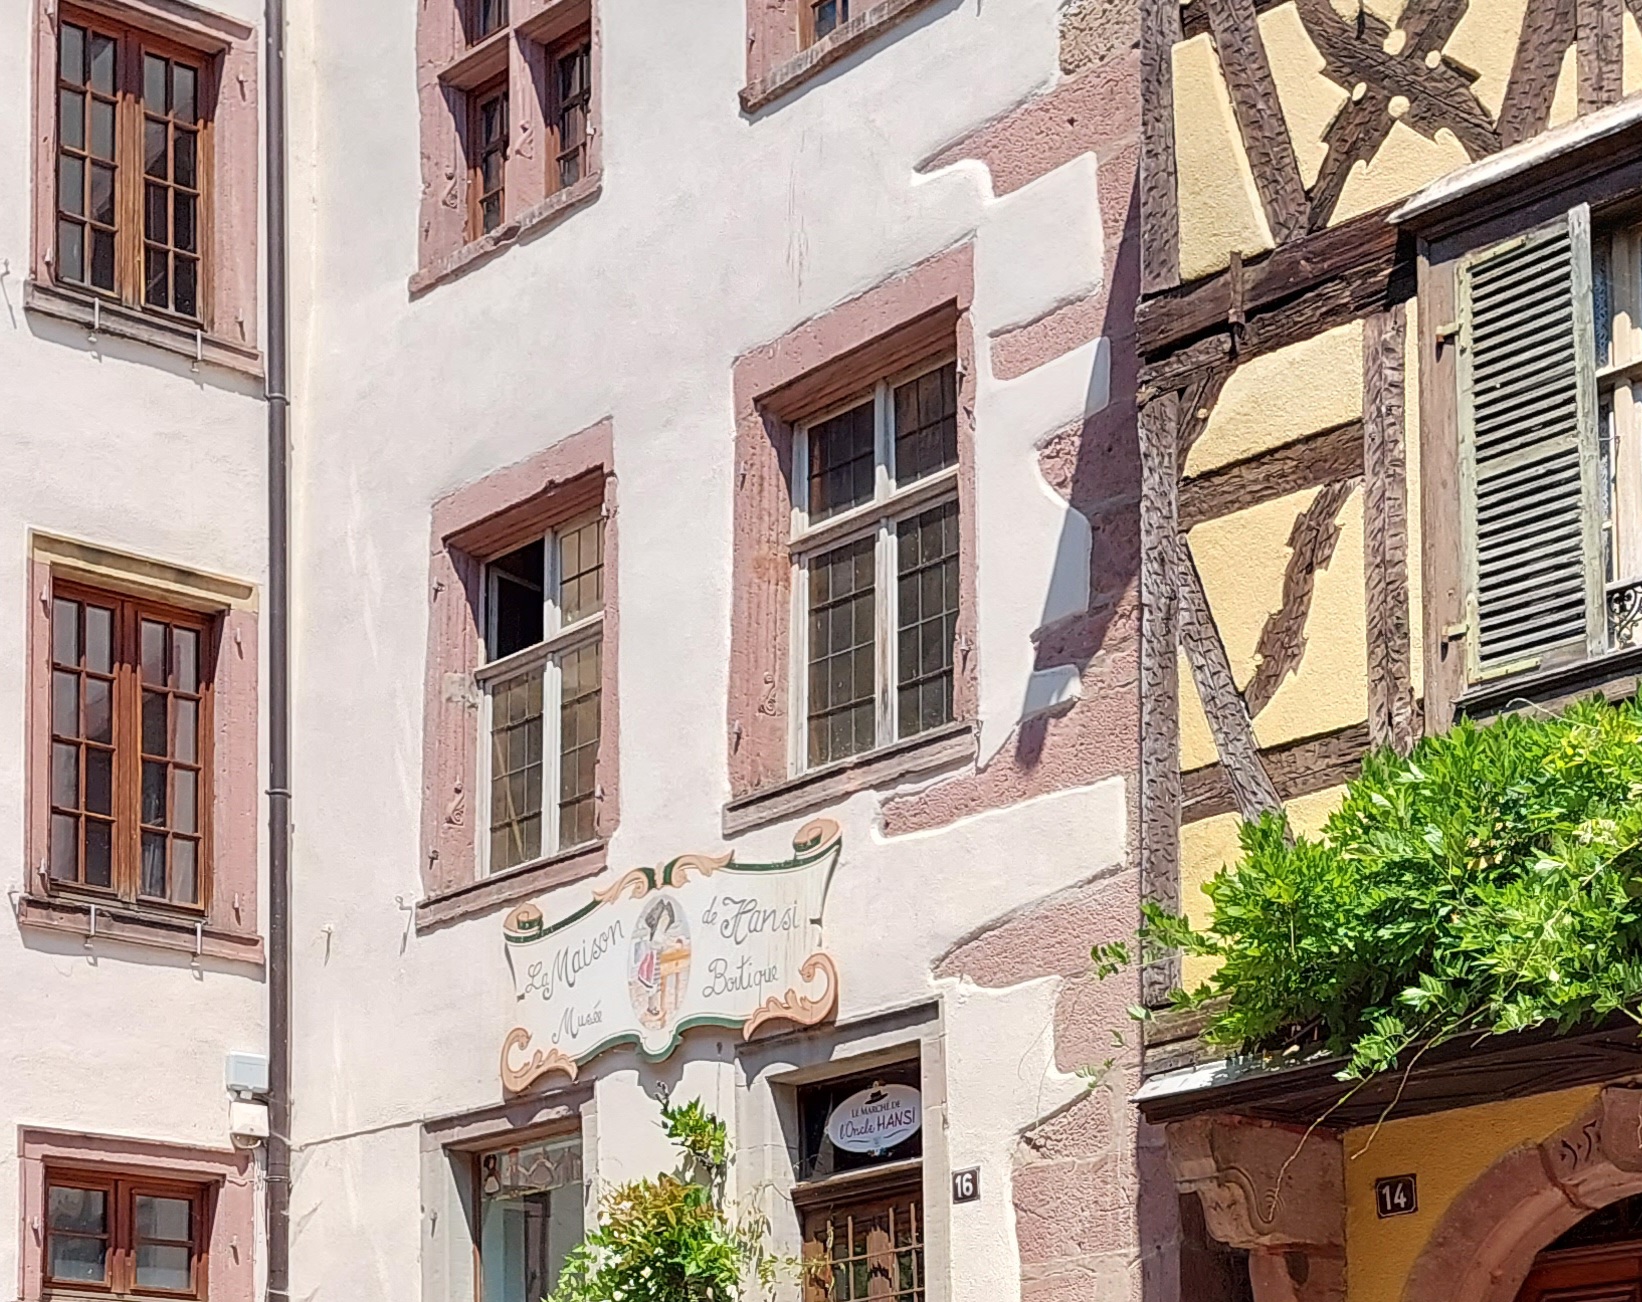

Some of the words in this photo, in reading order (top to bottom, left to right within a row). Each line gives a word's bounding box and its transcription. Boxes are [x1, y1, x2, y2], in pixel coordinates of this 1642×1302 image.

[525, 961, 549, 993] La
[542, 919, 624, 1001] Maison
[702, 895, 718, 925] de
[720, 896, 800, 945] Hansi
[551, 999, 603, 1044] Musée
[702, 955, 779, 1004] Boutique
[851, 1108, 860, 1118] LE
[891, 1100, 901, 1109] DE
[877, 1106, 915, 1131] HANSI
[955, 1173, 973, 1198] 16
[1382, 1183, 1407, 1210] 14
